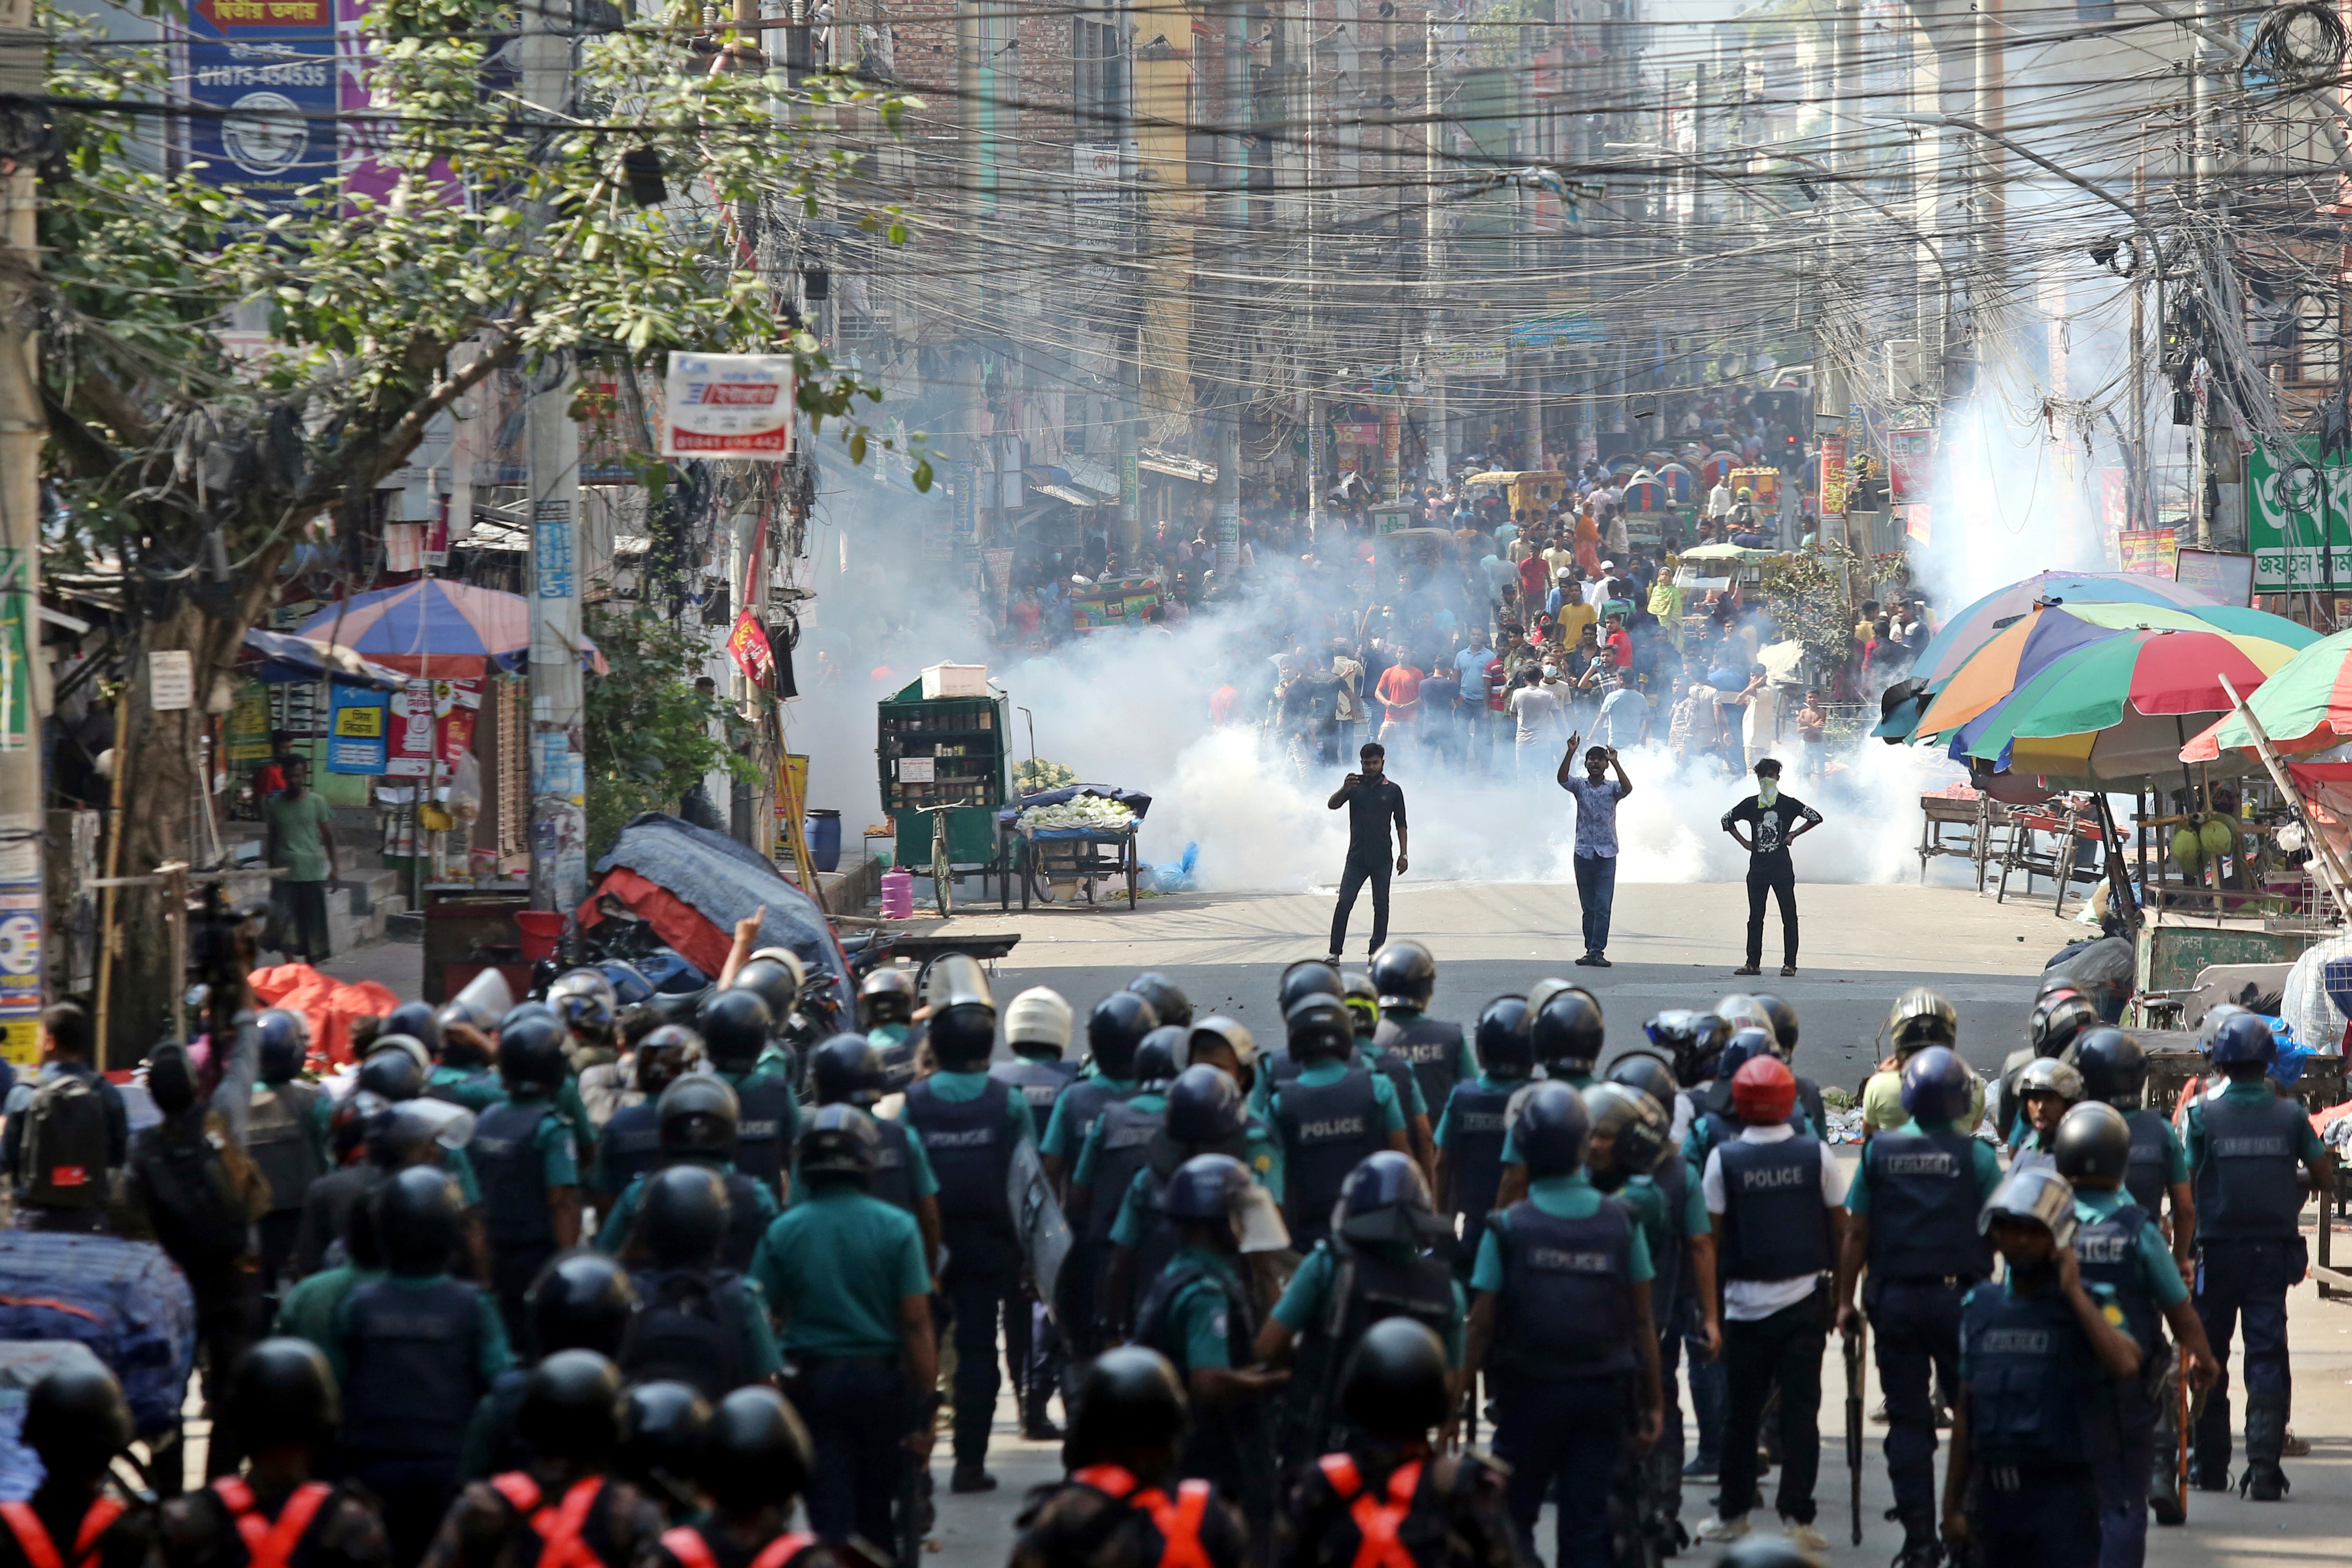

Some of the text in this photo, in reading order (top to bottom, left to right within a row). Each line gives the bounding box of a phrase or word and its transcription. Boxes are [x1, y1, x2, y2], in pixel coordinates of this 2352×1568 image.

[268, 0, 318, 20] তলায়
[198, 65, 325, 86] 01875-454535
[1300, 1117, 1364, 1139] POLICE
[1892, 1156, 1947, 1174] POLICE
[1744, 1165, 1803, 1188] POLICE
